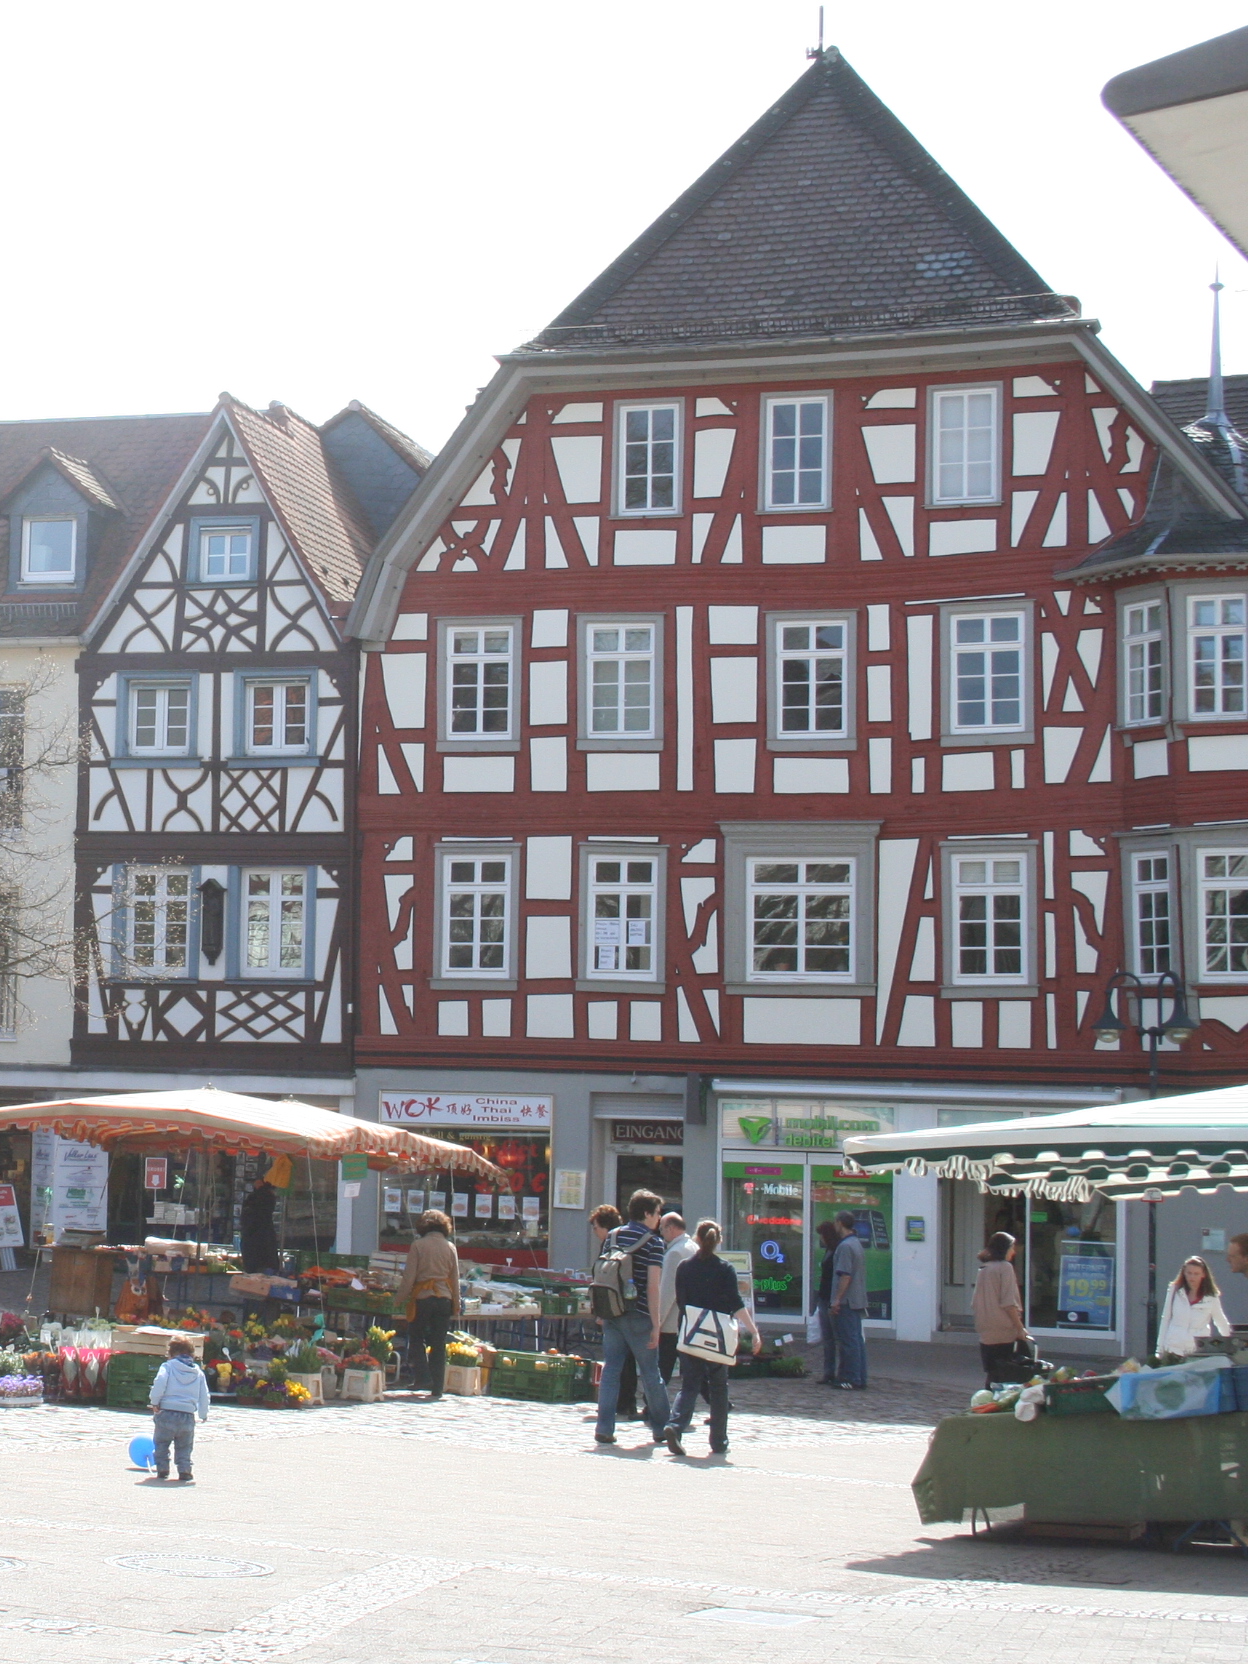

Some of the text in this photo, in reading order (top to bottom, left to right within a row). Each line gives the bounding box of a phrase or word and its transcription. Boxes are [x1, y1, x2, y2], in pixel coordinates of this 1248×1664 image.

[475, 1097, 518, 1106] China
[382, 1096, 444, 1119] WOK
[480, 1106, 512, 1114] Thai
[472, 1114, 520, 1122] Imbiss
[785, 1115, 880, 1132] mobilcom
[446, 1131, 456, 1140] &
[784, 1133, 838, 1148] debitel
